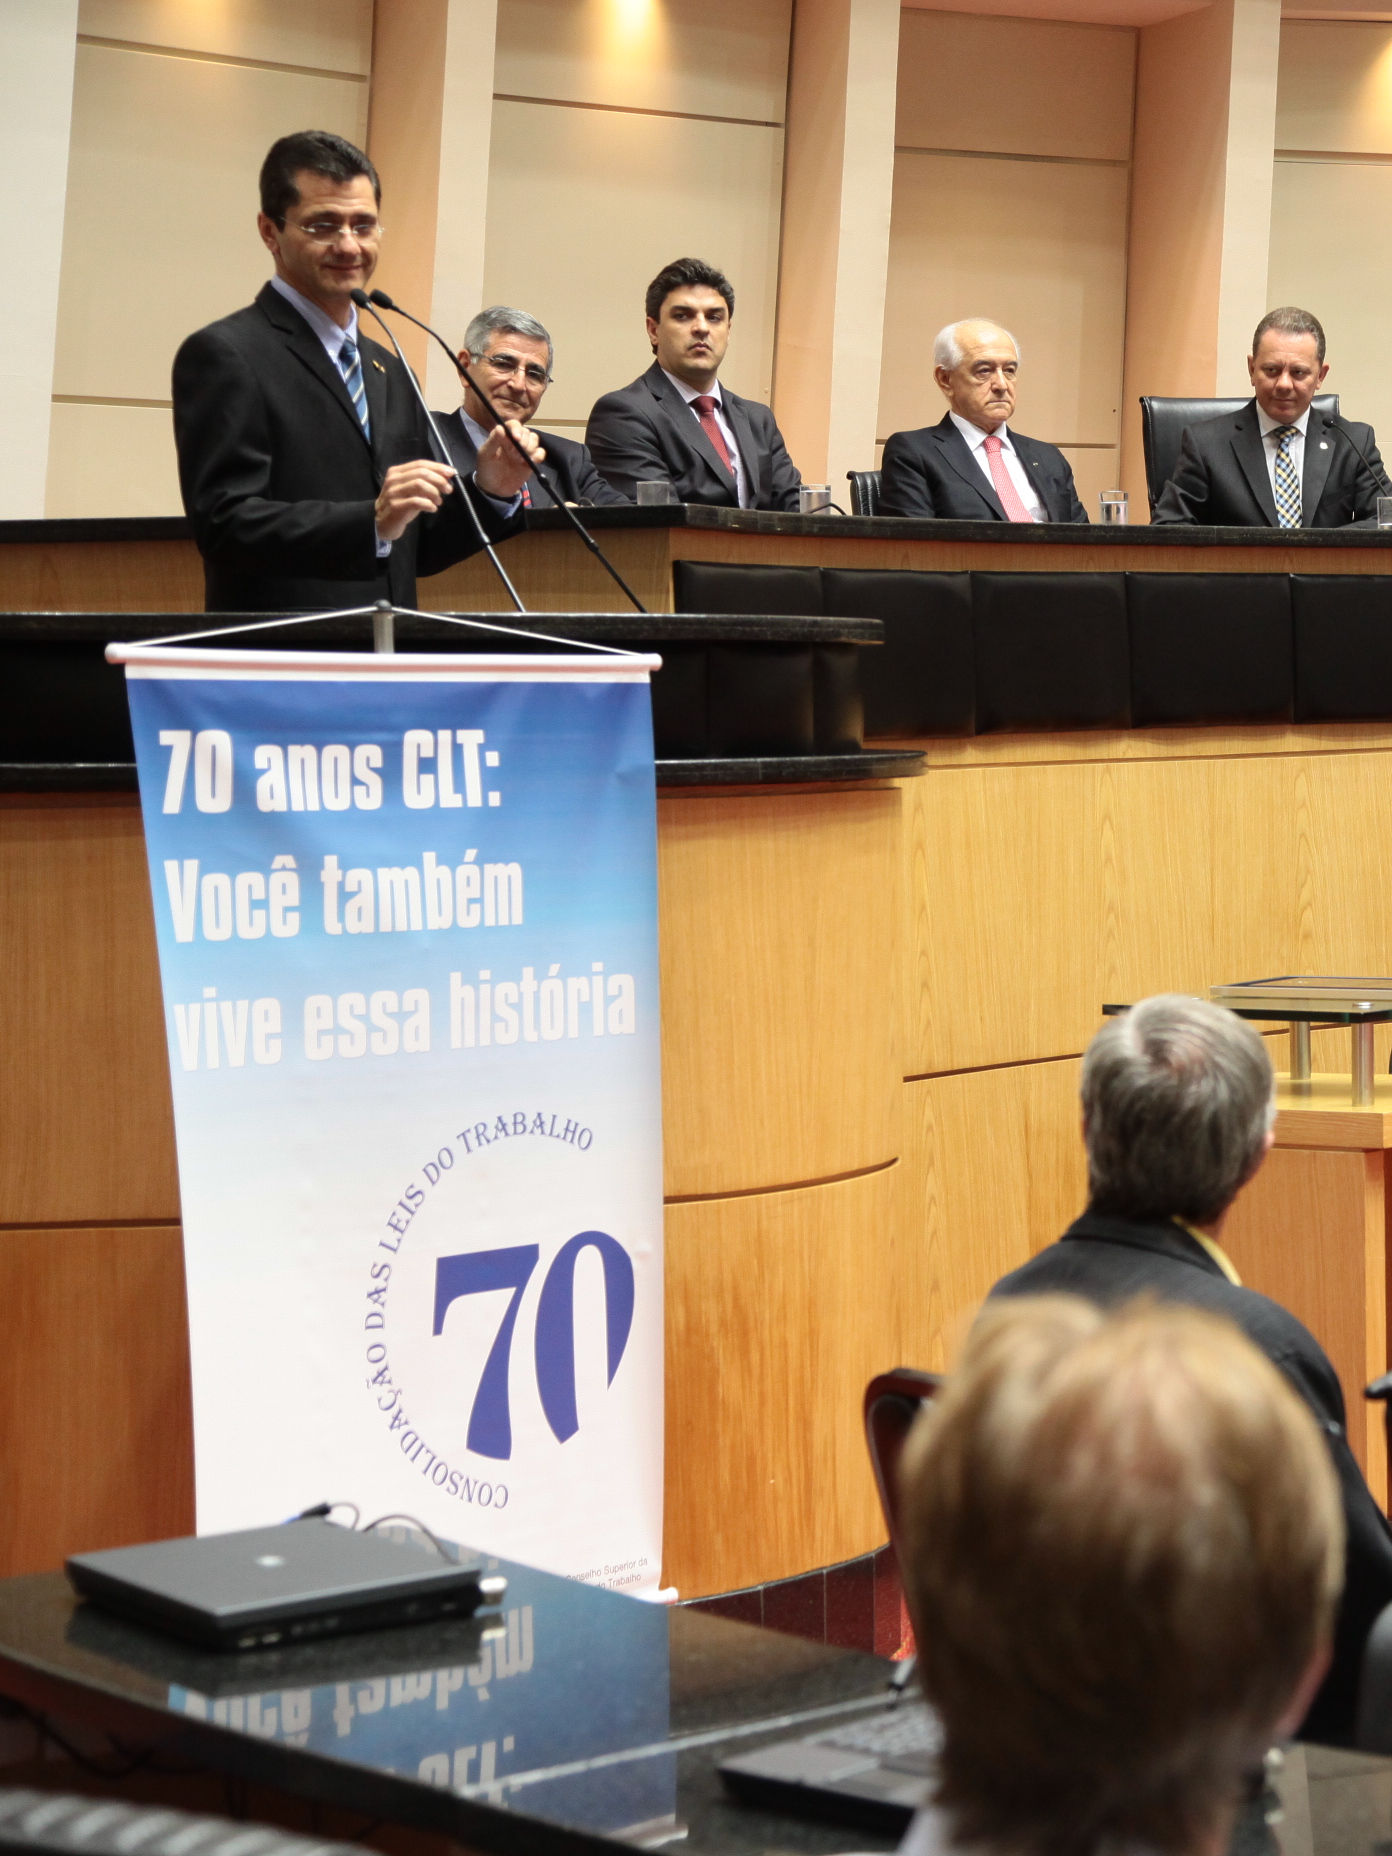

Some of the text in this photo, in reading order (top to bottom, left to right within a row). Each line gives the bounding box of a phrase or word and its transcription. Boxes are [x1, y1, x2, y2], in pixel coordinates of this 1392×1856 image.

[159, 729, 501, 814] 70 anos CLT:
[163, 849, 523, 943] Você também
[173, 961, 636, 1072] vive essa história
[422, 1146, 454, 1187] DO
[456, 1111, 593, 1154] TRABALHO
[378, 1183, 426, 1255] LEIS
[364, 1262, 393, 1331] DAS
[432, 1230, 635, 1461] 70
[365, 1342, 509, 1510] CONSOLIDAÇÃO
[603, 1559, 637, 1576] Superior
[638, 1557, 648, 1567] da
[608, 1574, 642, 1589] Trabalho
